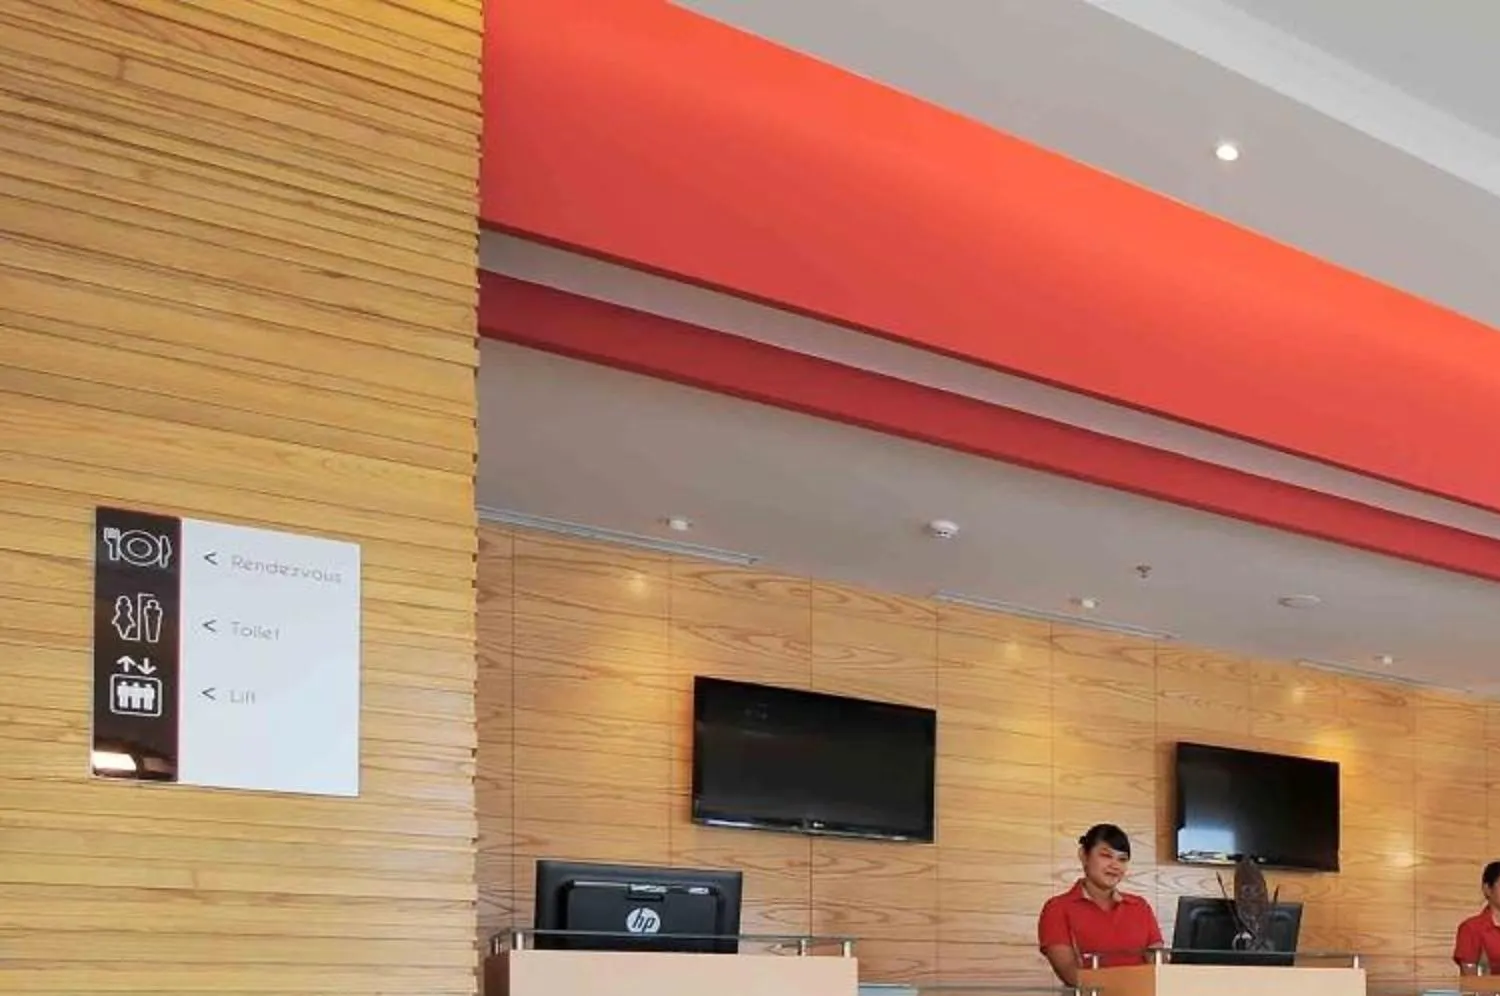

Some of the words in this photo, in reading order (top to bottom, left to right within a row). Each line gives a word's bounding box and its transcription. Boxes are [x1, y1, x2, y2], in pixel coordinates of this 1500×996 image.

[230, 553, 342, 584] Rendezvous
[230, 620, 281, 641] Toilet
[629, 906, 660, 935] hp
